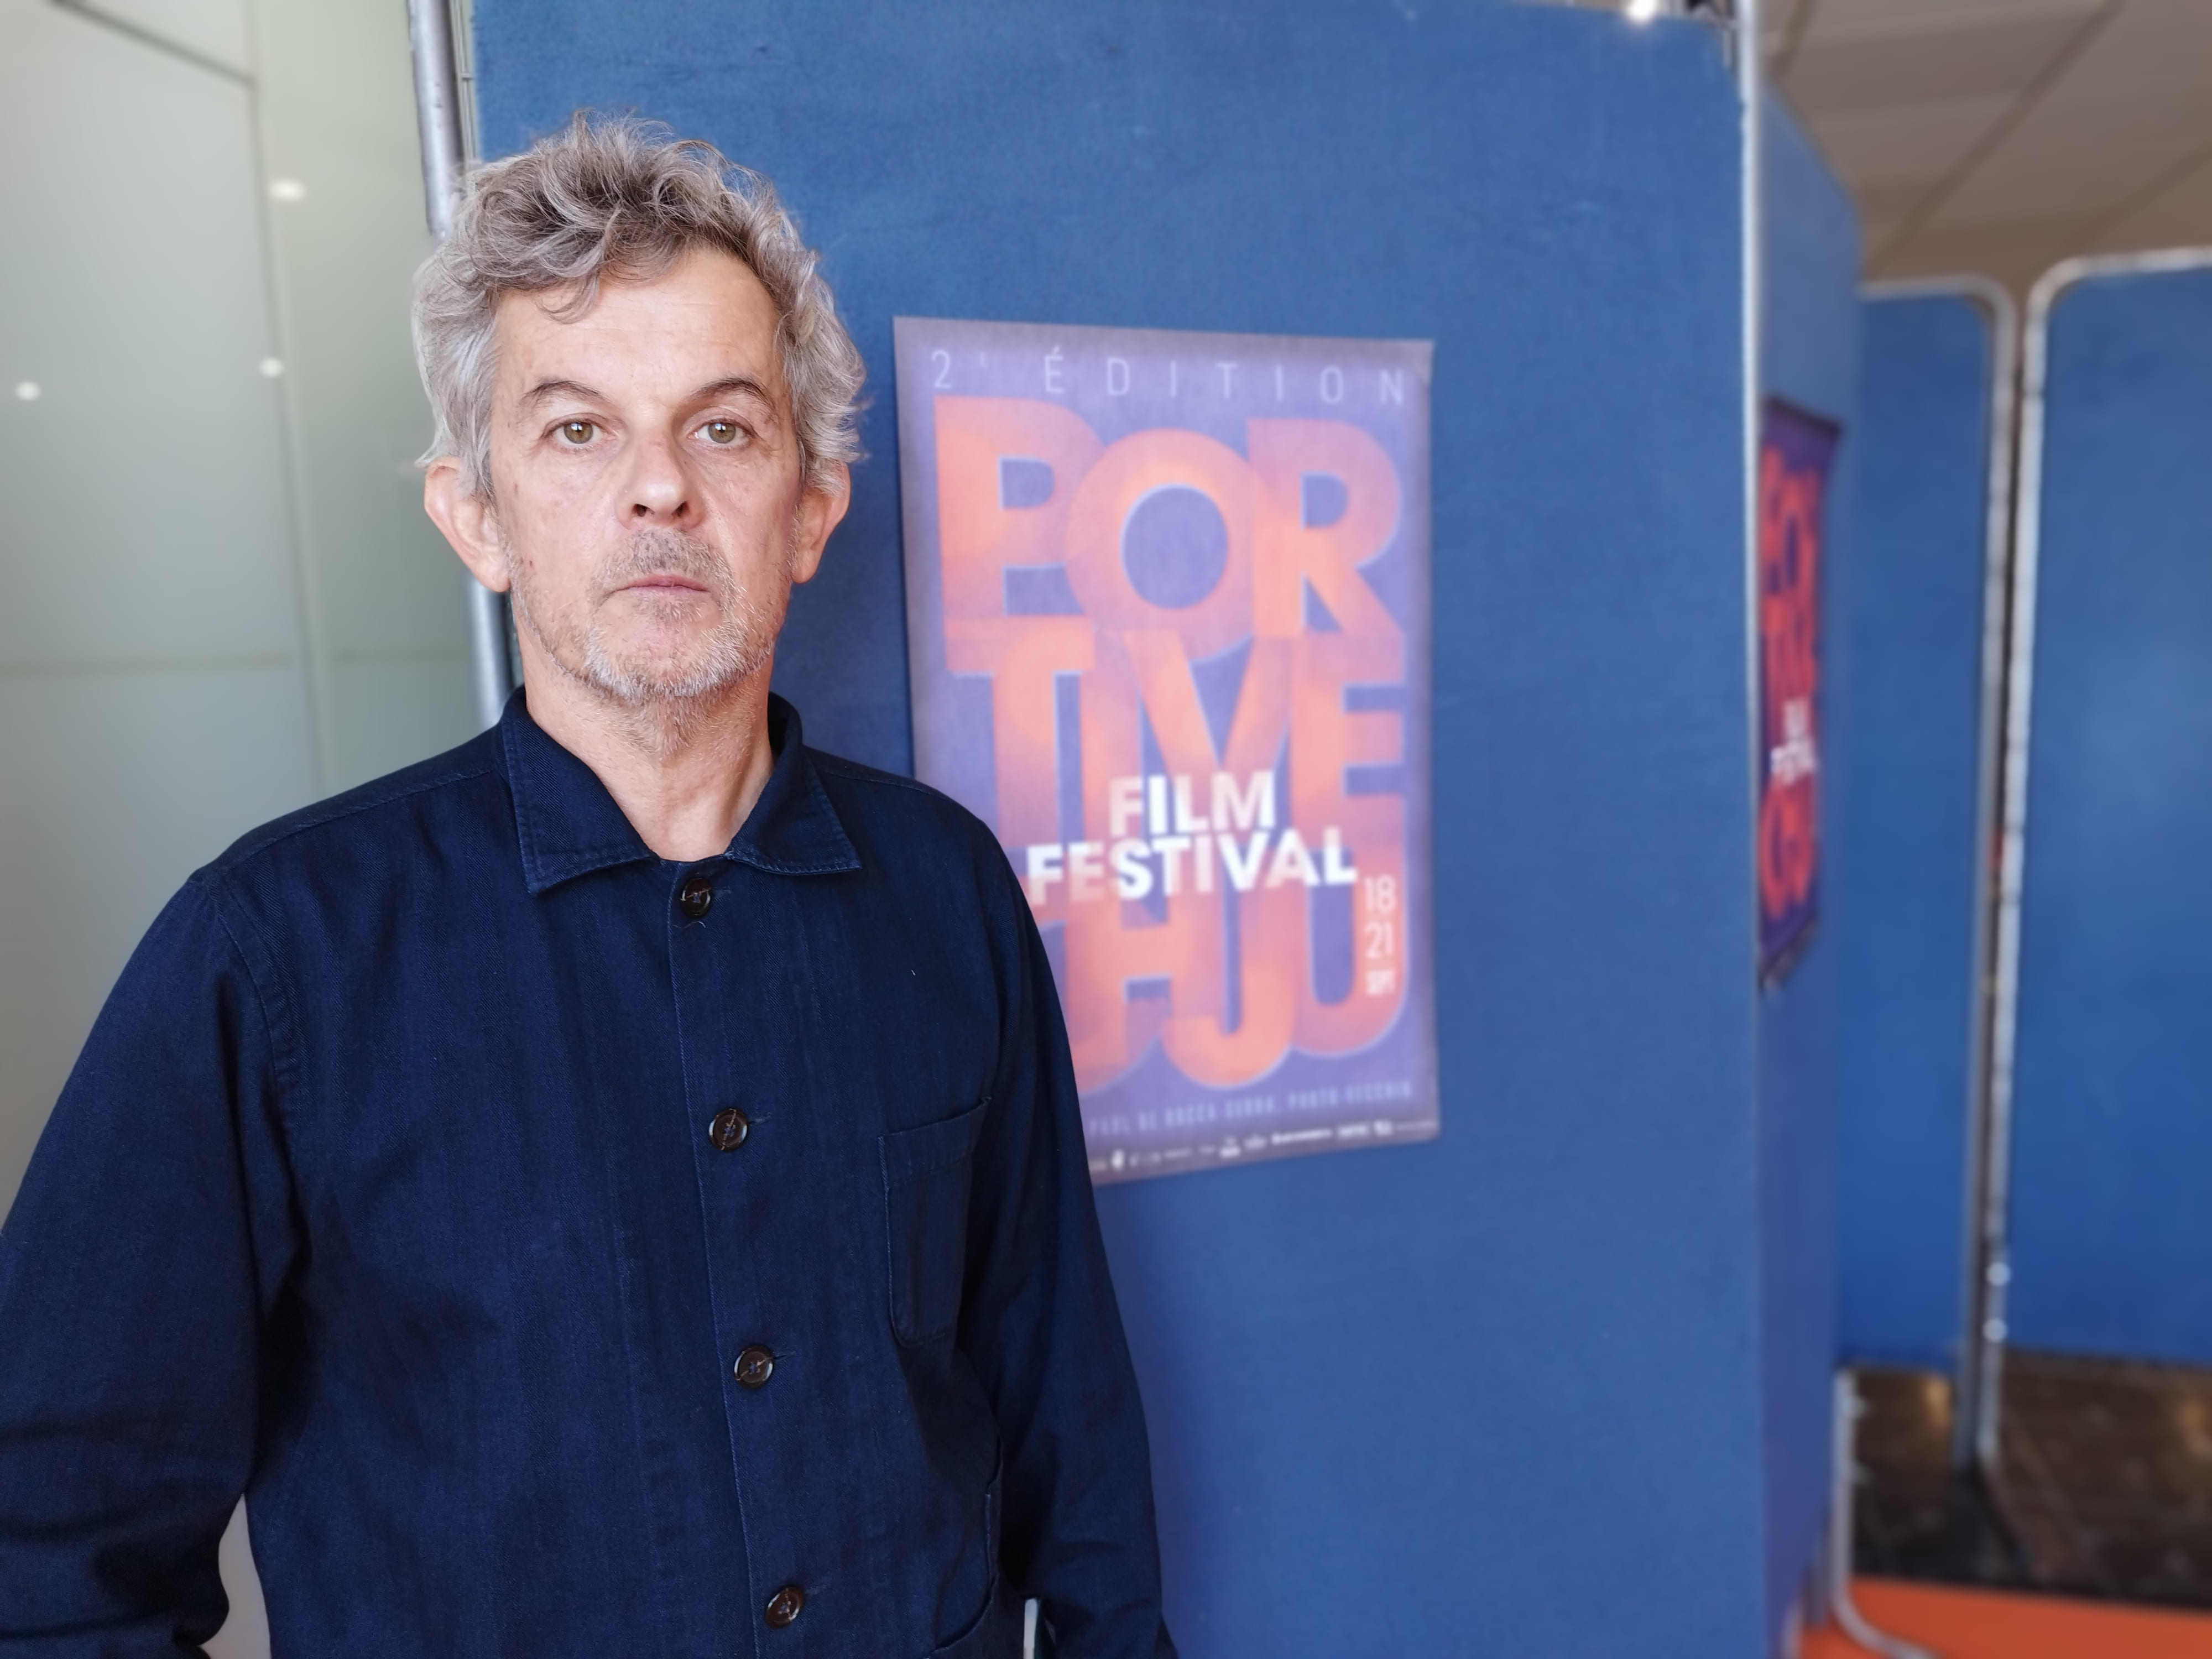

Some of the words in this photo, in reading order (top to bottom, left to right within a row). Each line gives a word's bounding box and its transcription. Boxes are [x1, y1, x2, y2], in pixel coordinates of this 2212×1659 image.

[1044, 346, 1405, 405] ÉDITION
[933, 395, 1405, 662] POR
[943, 615, 1407, 851] TIVE
[1109, 770, 1276, 837] FILM
[1026, 827, 1358, 905] FESTIVAL
[1362, 875, 1396, 914] 18
[1362, 920, 1392, 960] 21
